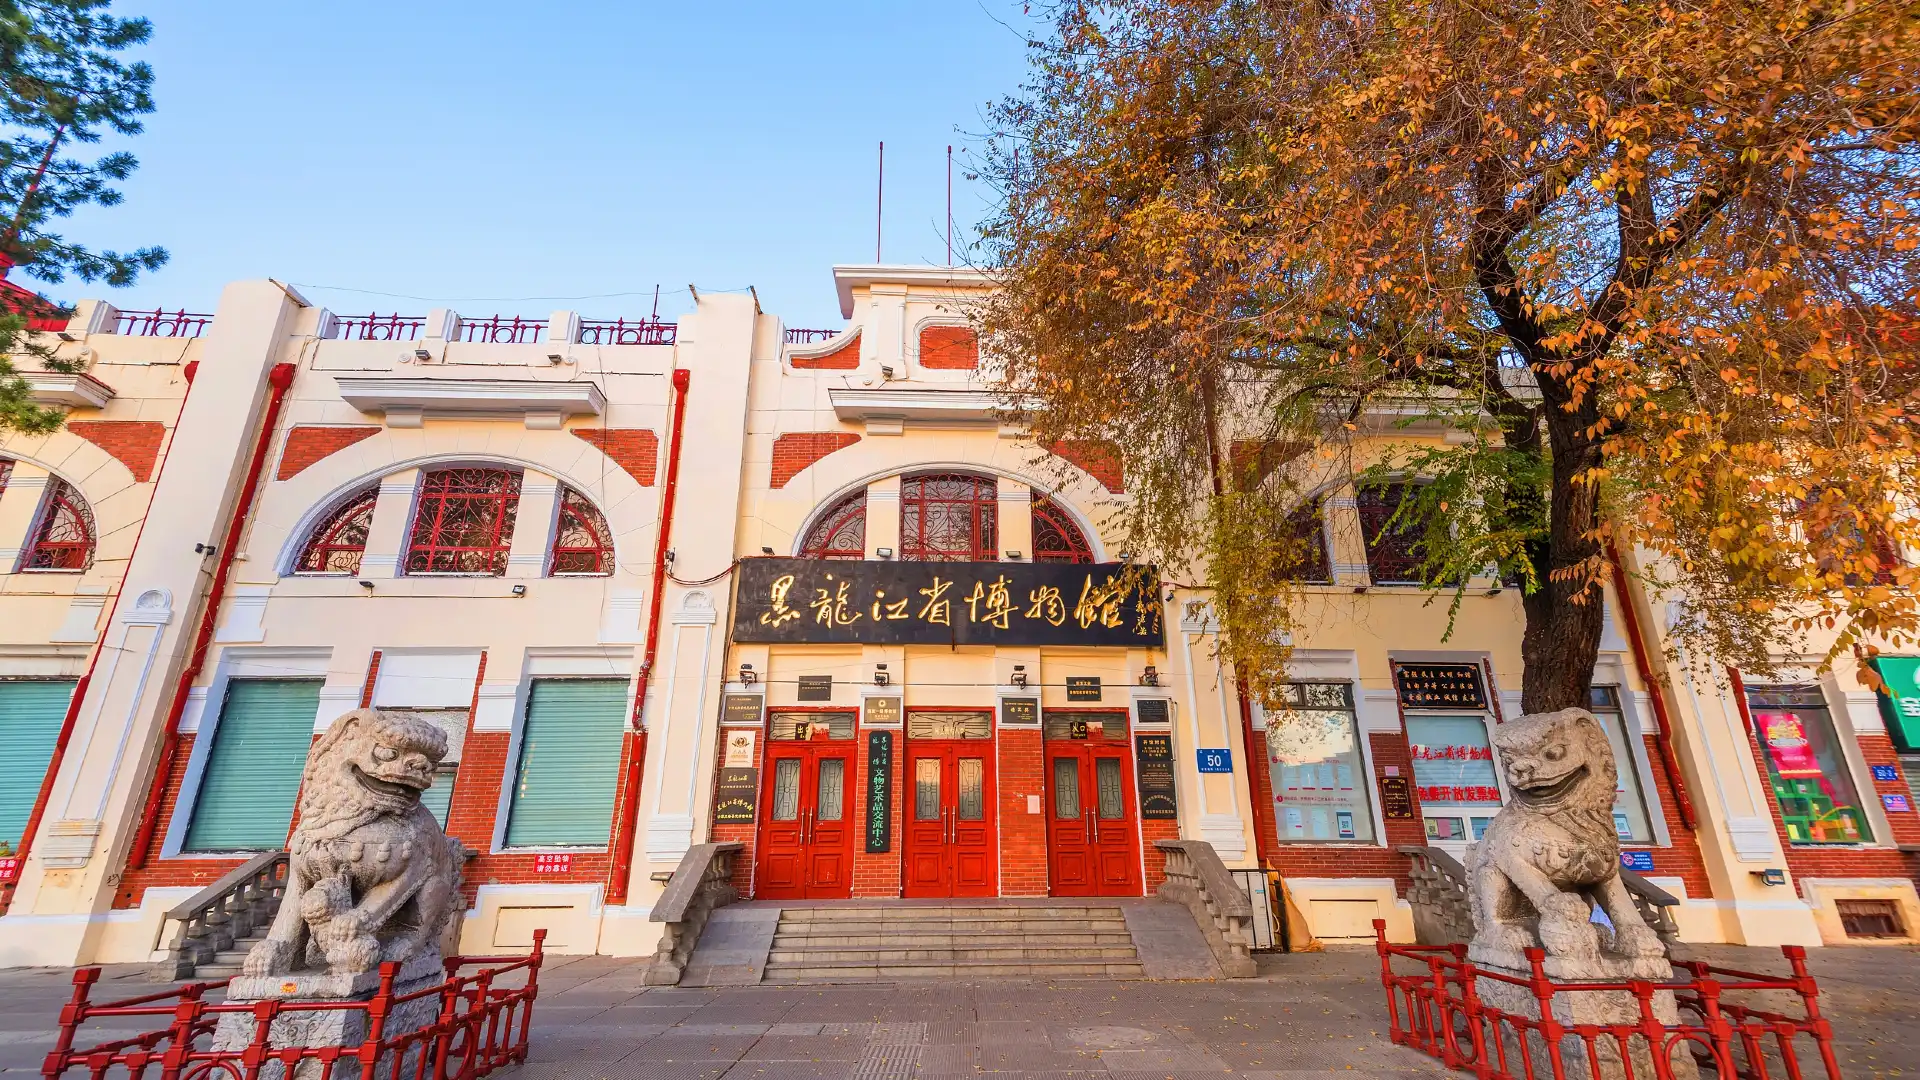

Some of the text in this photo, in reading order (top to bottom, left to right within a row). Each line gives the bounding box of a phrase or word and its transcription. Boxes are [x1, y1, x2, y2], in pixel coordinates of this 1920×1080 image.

[1207, 755, 1222, 767] 50
[1418, 786, 1501, 801] 免费开放发票处
[872, 768, 885, 847] 文物艺术品交流中心
[536, 864, 568, 872] 请勿靠近
